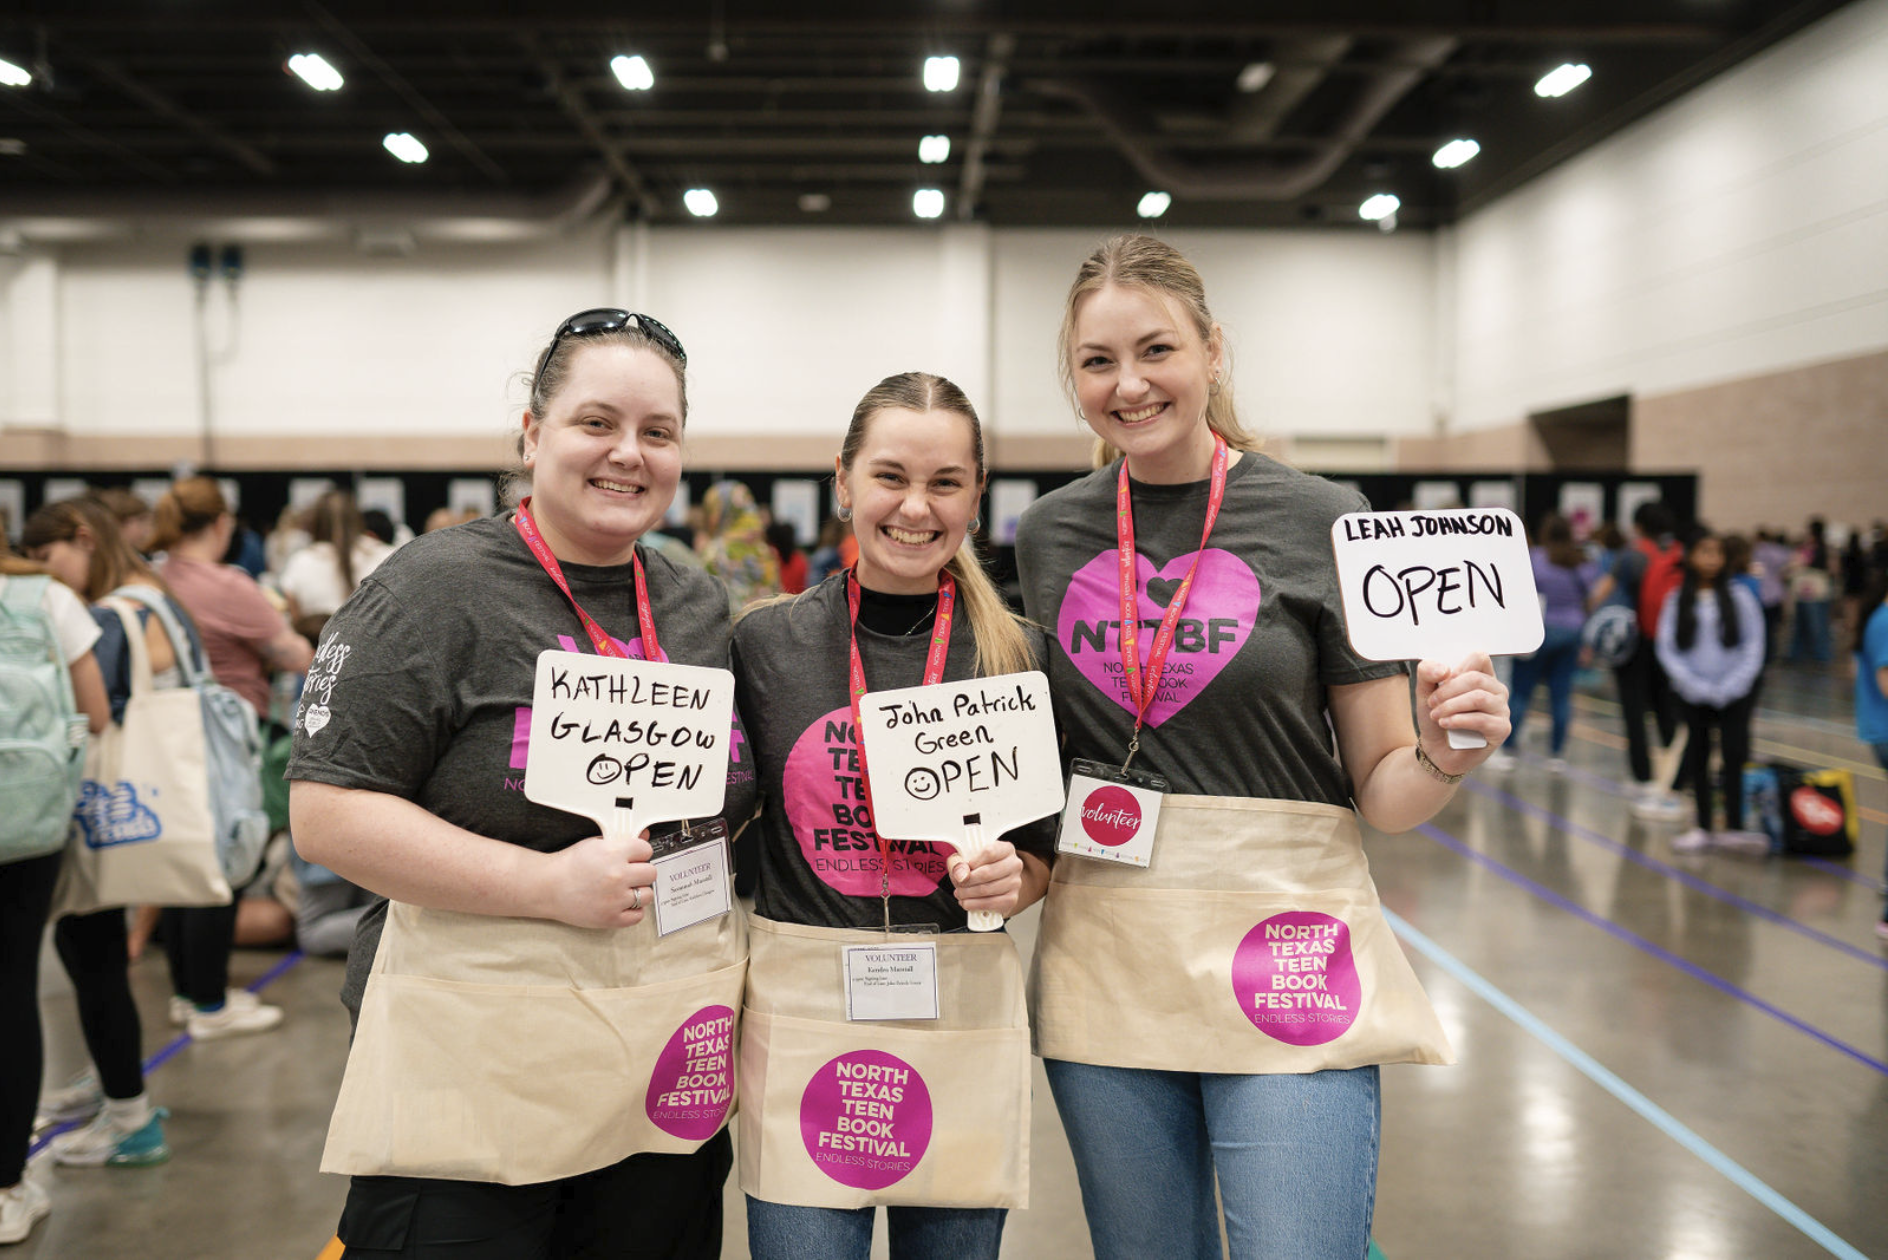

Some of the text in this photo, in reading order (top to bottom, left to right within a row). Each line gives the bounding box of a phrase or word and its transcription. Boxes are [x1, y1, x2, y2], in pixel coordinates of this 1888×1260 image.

[1344, 514, 1513, 542] LEAH JOHNSON
[1363, 559, 1506, 626] OPEN
[1161, 662, 1194, 676] EXAS
[551, 666, 711, 711] KATHLEEN
[1158, 677, 1189, 690] OOK
[878, 685, 1037, 730] John Patrick
[550, 711, 716, 750] GLASGOW
[914, 724, 995, 755] Green
[834, 775, 867, 801] TE
[832, 803, 873, 829] BO
[1080, 802, 1142, 830] volunteer
[1265, 924, 1338, 940] NORTH
[865, 953, 918, 963] VOLUNTEER
[1268, 938, 1336, 957] TEXAS
[1273, 956, 1328, 973] TEEN
[1271, 974, 1328, 991] BOOK
[1254, 992, 1348, 1010] FESTIVAL
[683, 1015, 734, 1043] NORTH
[1254, 1012, 1351, 1025] ENDLESS STORIES
[685, 1033, 731, 1059] TEXAS
[685, 1052, 727, 1073] TEEN
[836, 1061, 909, 1085] NORTH
[675, 1070, 727, 1090] BOOK
[838, 1080, 904, 1103] TEXAS
[656, 1084, 731, 1108] FESTIVAL
[652, 1110, 701, 1120] ENDLESS
[842, 1098, 895, 1121] TEEN
[837, 1115, 895, 1139] BOOK
[818, 1131, 911, 1158] FESTIVAL
[816, 1152, 911, 1172] ENDLESS STORIES
